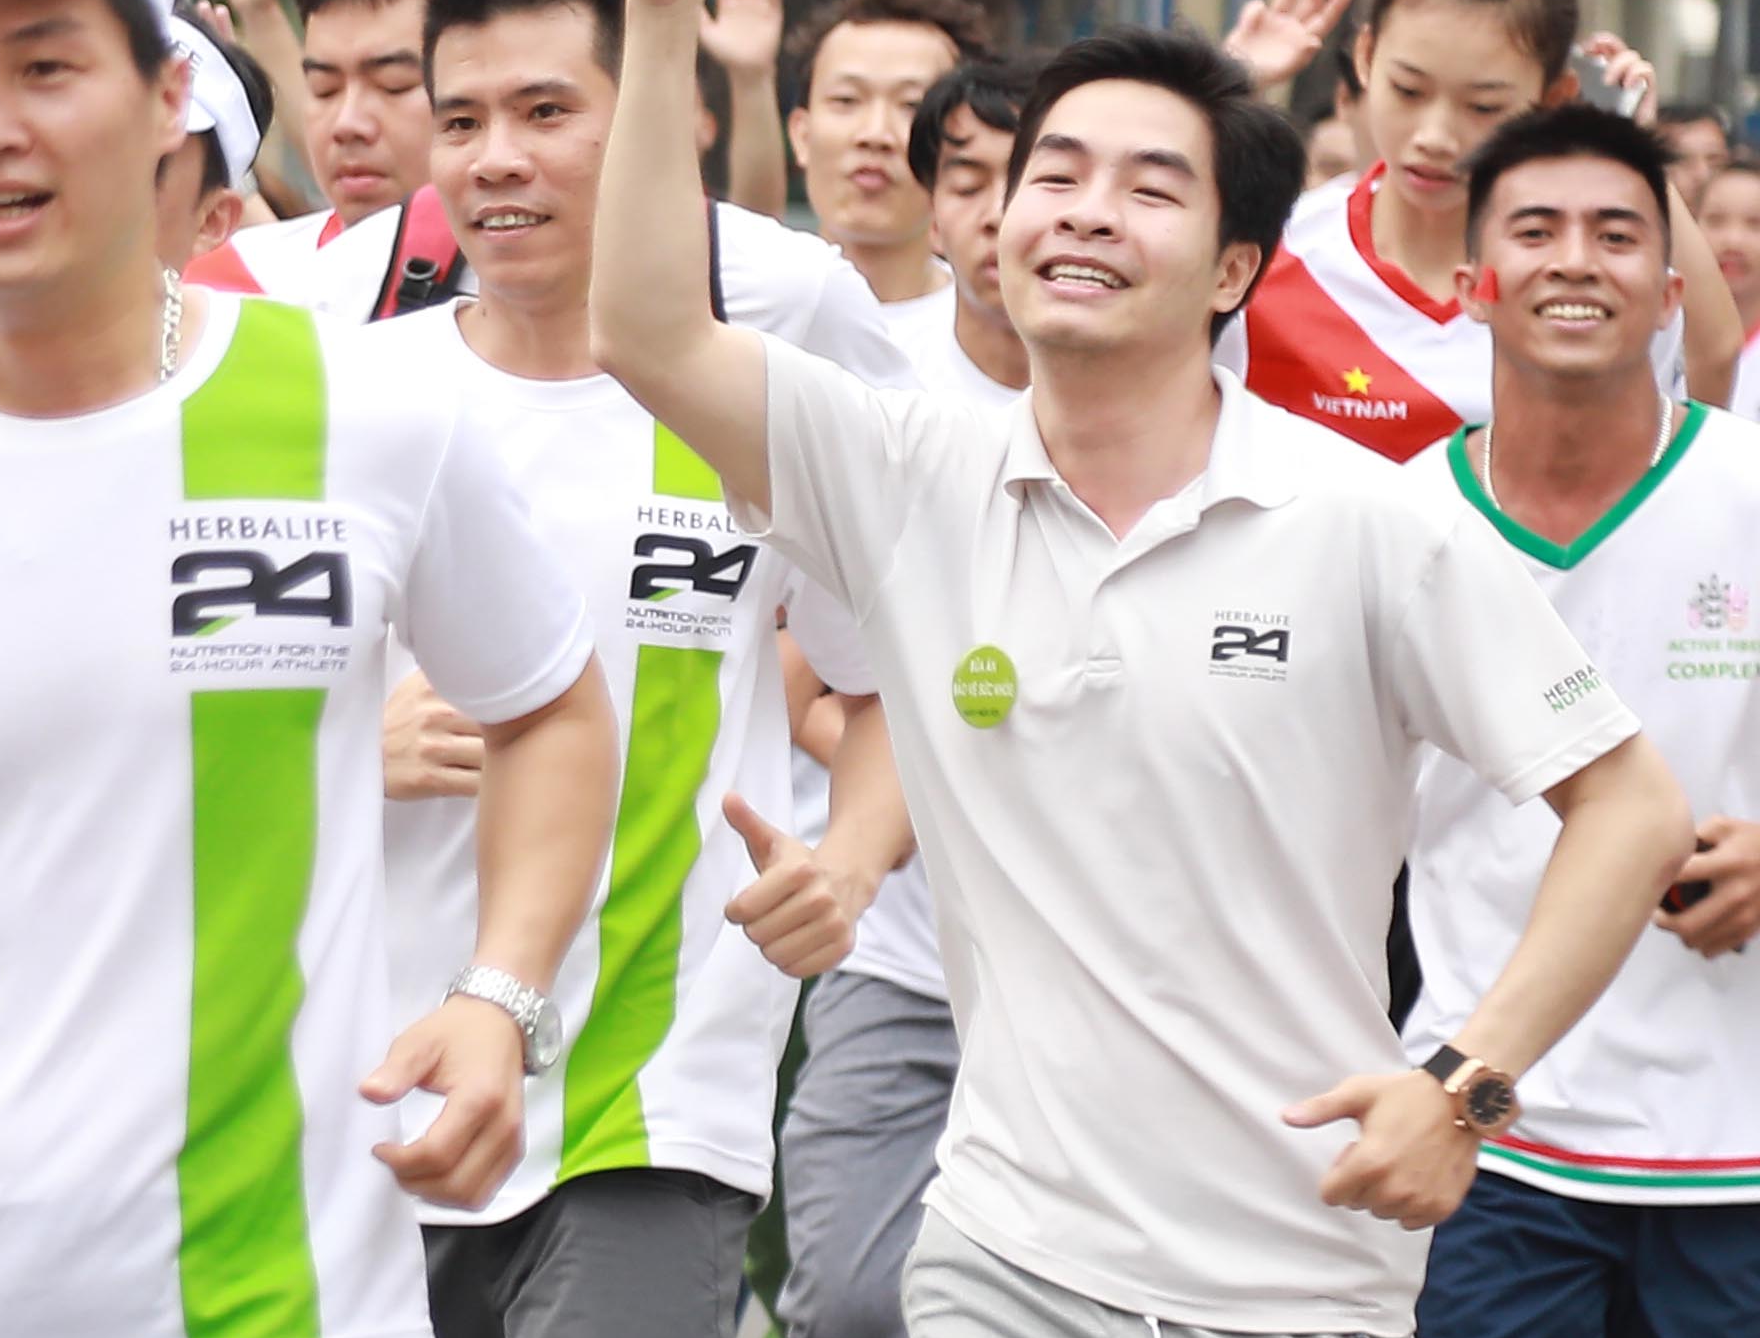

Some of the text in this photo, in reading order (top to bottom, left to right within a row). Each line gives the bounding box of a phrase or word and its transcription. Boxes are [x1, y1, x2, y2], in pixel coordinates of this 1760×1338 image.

[1312, 391, 1408, 421] VIETNAM
[170, 516, 348, 542] HERBALIFE
[637, 506, 737, 534] HERBAL
[629, 533, 760, 603] 24
[171, 549, 354, 639] 24
[626, 607, 698, 624] NUTRITION
[1215, 610, 1289, 626] HERBALIFE
[170, 644, 351, 659] NUTRITION FOR THE
[1211, 625, 1290, 662] 24
[271, 659, 348, 671] ATHLETE
[1667, 662, 1760, 679] COMPLE
[1543, 664, 1598, 703] HERBA
[1551, 676, 1601, 714] NUTRI
